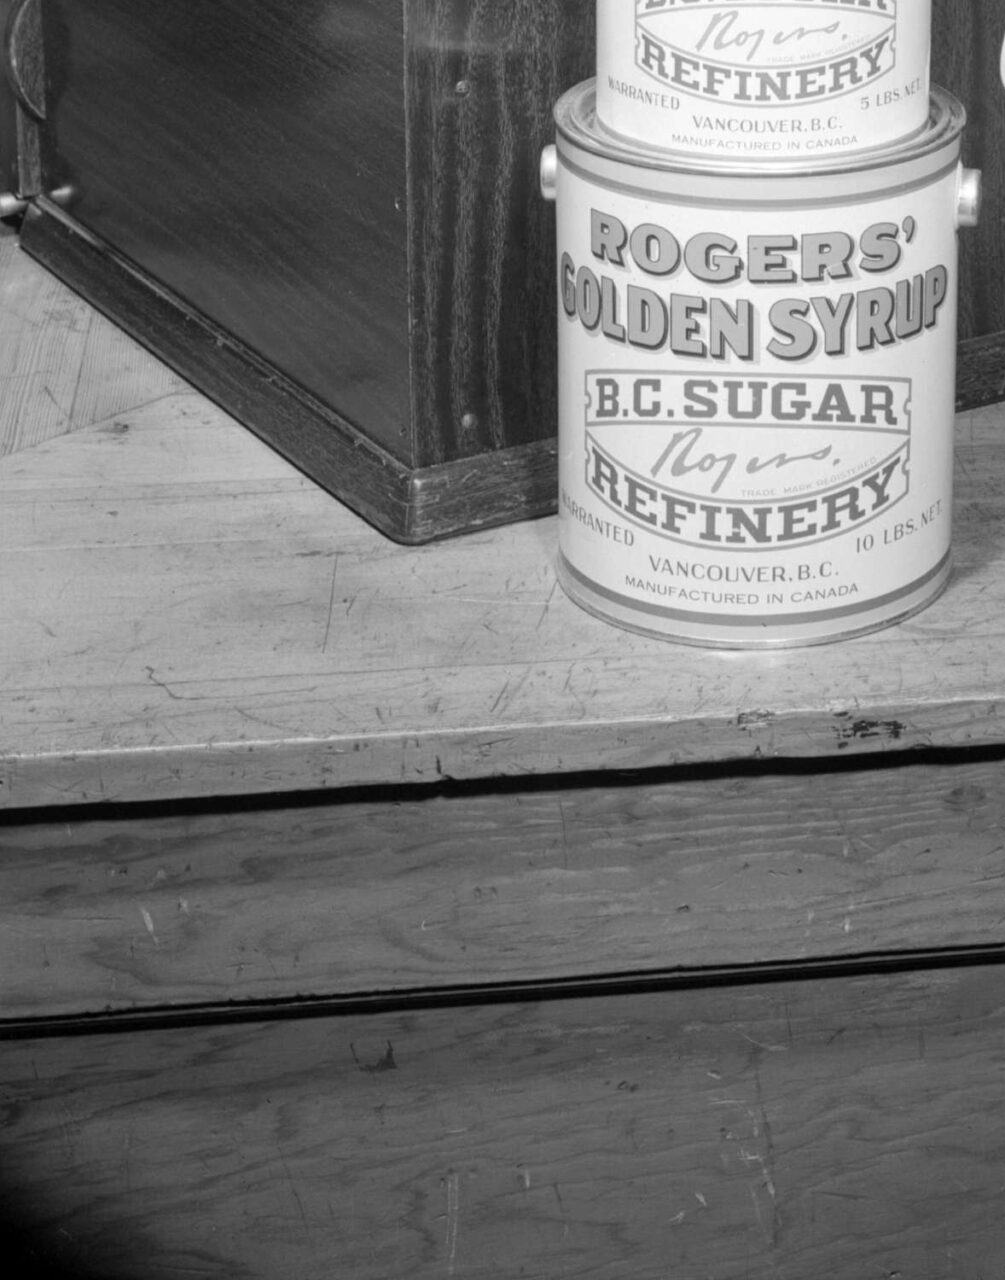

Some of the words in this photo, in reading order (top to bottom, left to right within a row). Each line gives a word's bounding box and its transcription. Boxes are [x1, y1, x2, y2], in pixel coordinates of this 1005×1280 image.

[640, 32, 890, 102] REFINERY
[607, 74, 681, 111] WARRANTED
[860, 97, 871, 111] 5
[671, 133, 782, 152] MANUFACTURED
[786, 139, 801, 152] IN
[806, 135, 859, 149] CANADA
[590, 207, 917, 285] ROGERS'
[560, 251, 756, 363] GOLDEN
[765, 264, 949, 362] SYRUP
[596, 377, 675, 419] B.C.
[683, 379, 899, 426] SUGAR
[591, 445, 902, 545] REFINERY
[741, 488, 777, 498] TRADE
[783, 483, 813, 495] MARK
[816, 456, 878, 487] REGISTERED
[561, 487, 635, 547] WARRANTED
[856, 534, 875, 554] 10
[625, 574, 761, 606] MANUFACTURED
[766, 593, 784, 604] IN
[790, 582, 860, 603] CANADA
[797, 560, 840, 581] B.C.
